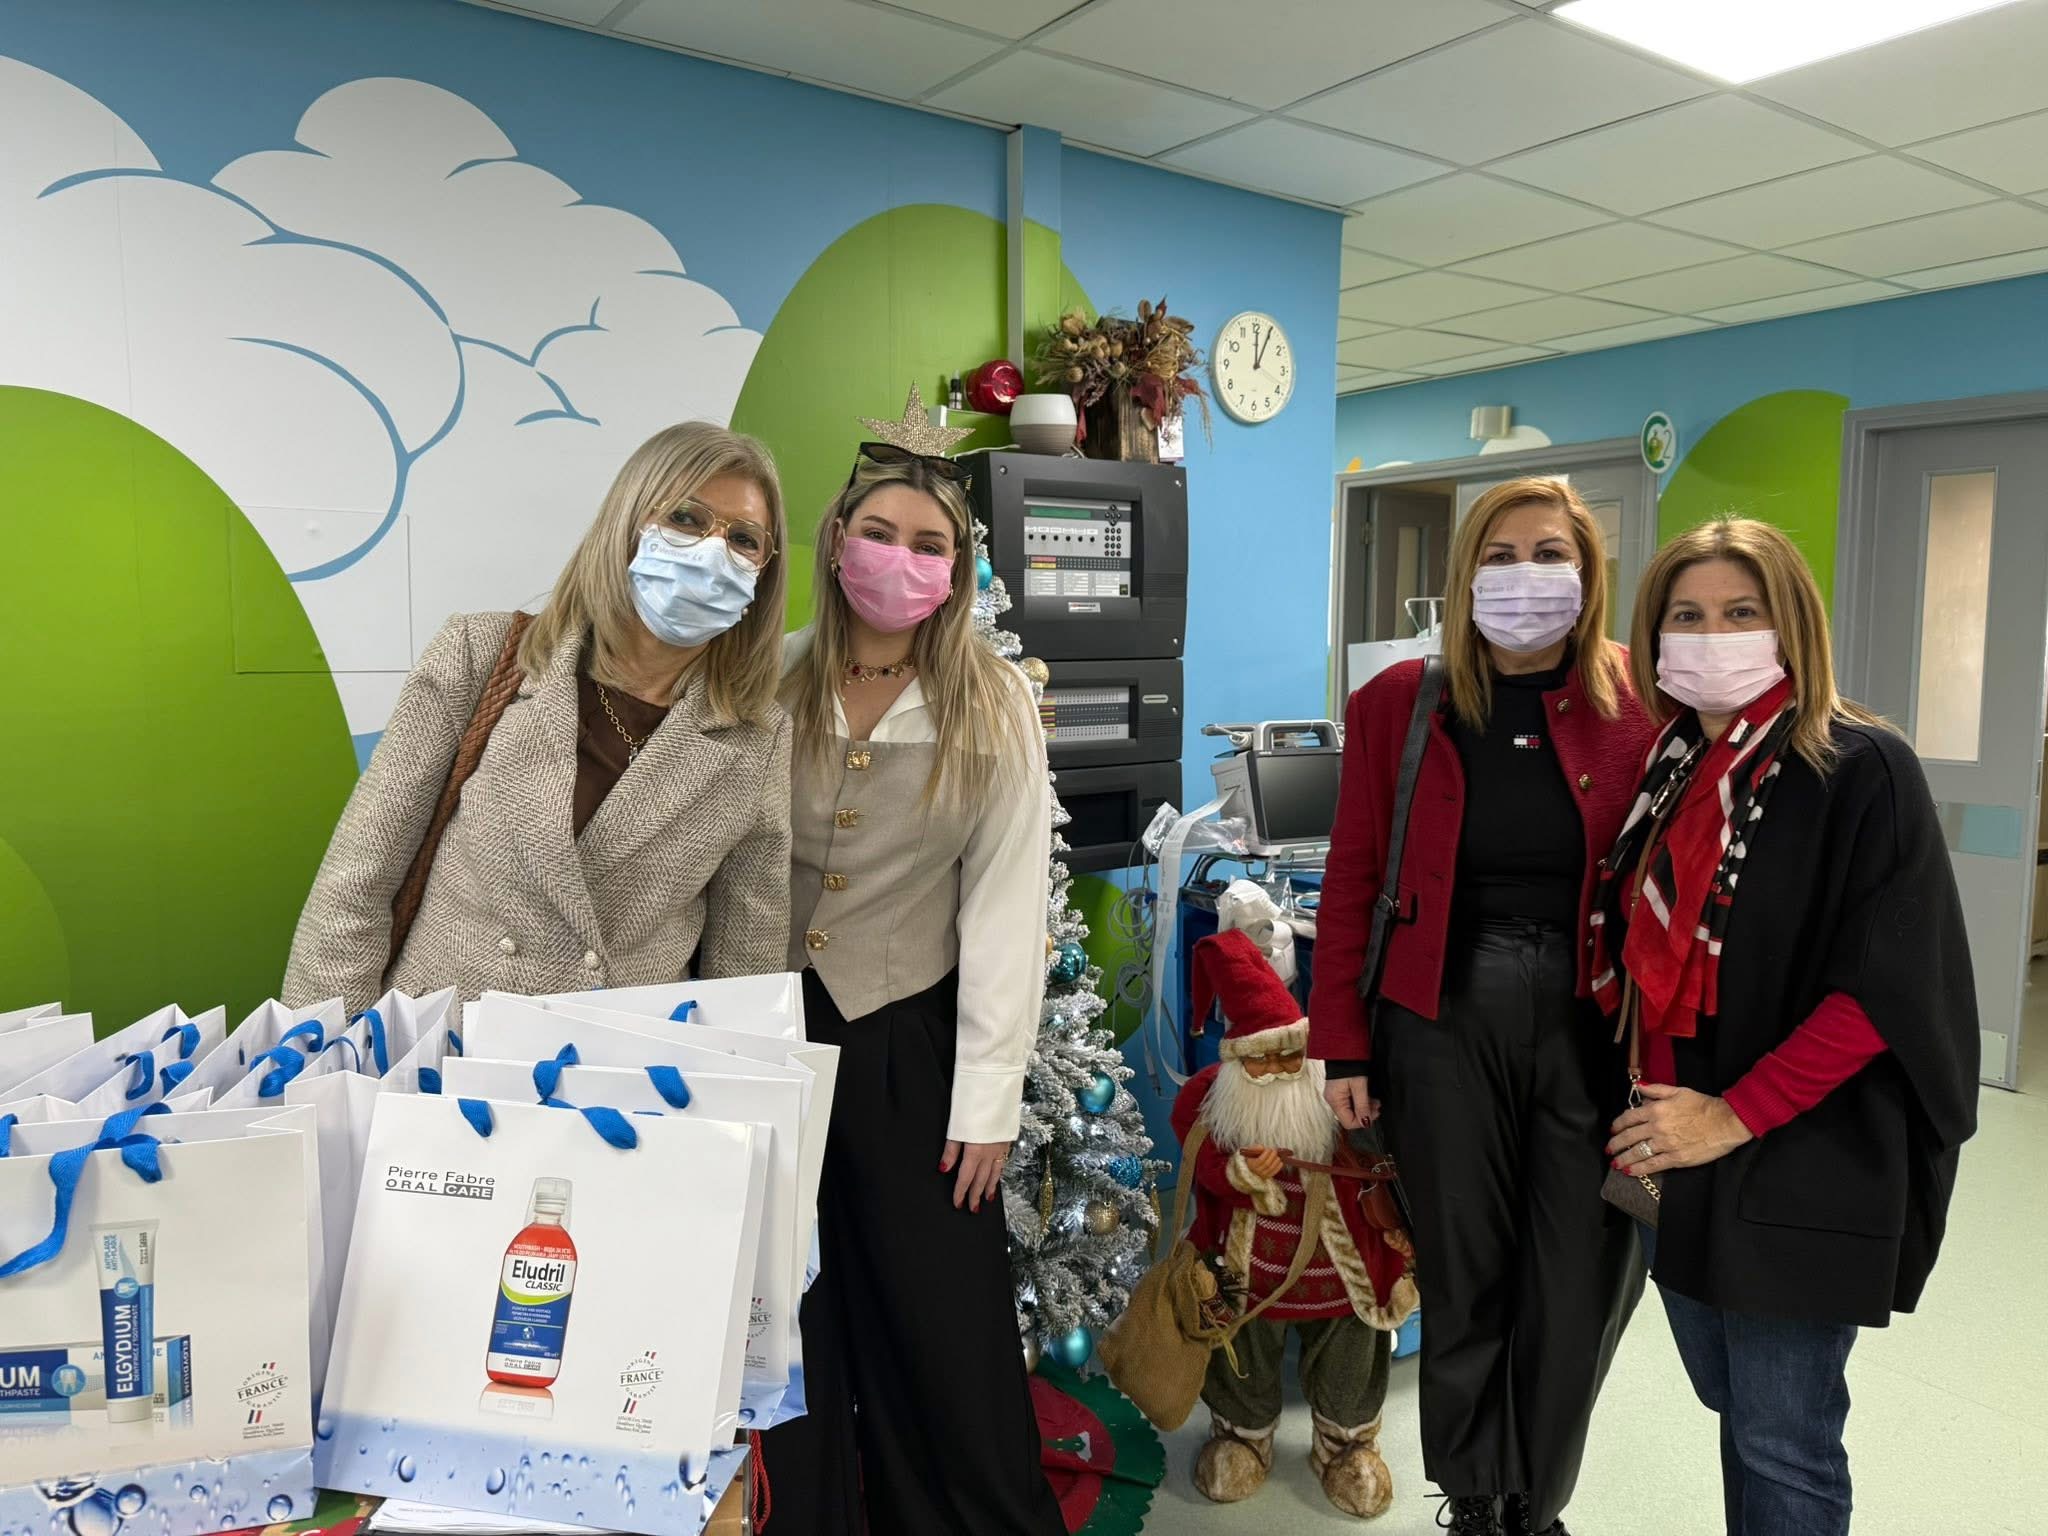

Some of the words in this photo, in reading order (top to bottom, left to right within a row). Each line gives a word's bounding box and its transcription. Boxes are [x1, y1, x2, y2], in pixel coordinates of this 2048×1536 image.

[1240, 327, 1246, 338] 11
[1252, 322, 1260, 334] 12
[1229, 340, 1240, 353] 10
[1276, 345, 1282, 356] 2
[1223, 358, 1230, 370] 9
[1280, 366, 1286, 376] 3
[1227, 379, 1233, 390] 8
[1274, 385, 1281, 395] 4
[1239, 394, 1245, 405] 7
[1264, 397, 1270, 408] 5
[1251, 400, 1257, 412] 6
[388, 1166, 438, 1180] Pierre
[445, 1171, 495, 1186] Fabre
[386, 1178, 438, 1192] ORAL
[445, 1185, 492, 1198] CARE
[512, 1259, 565, 1283] Eludril
[525, 1280, 563, 1292] CLASSIC
[749, 1314, 769, 1323] NCE
[115, 1304, 134, 1393] ELGYDIUM
[182, 1340, 190, 1394] ELGYDIUM
[620, 1370, 661, 1384] FRANCE
[237, 1377, 286, 1399] FRANCE
